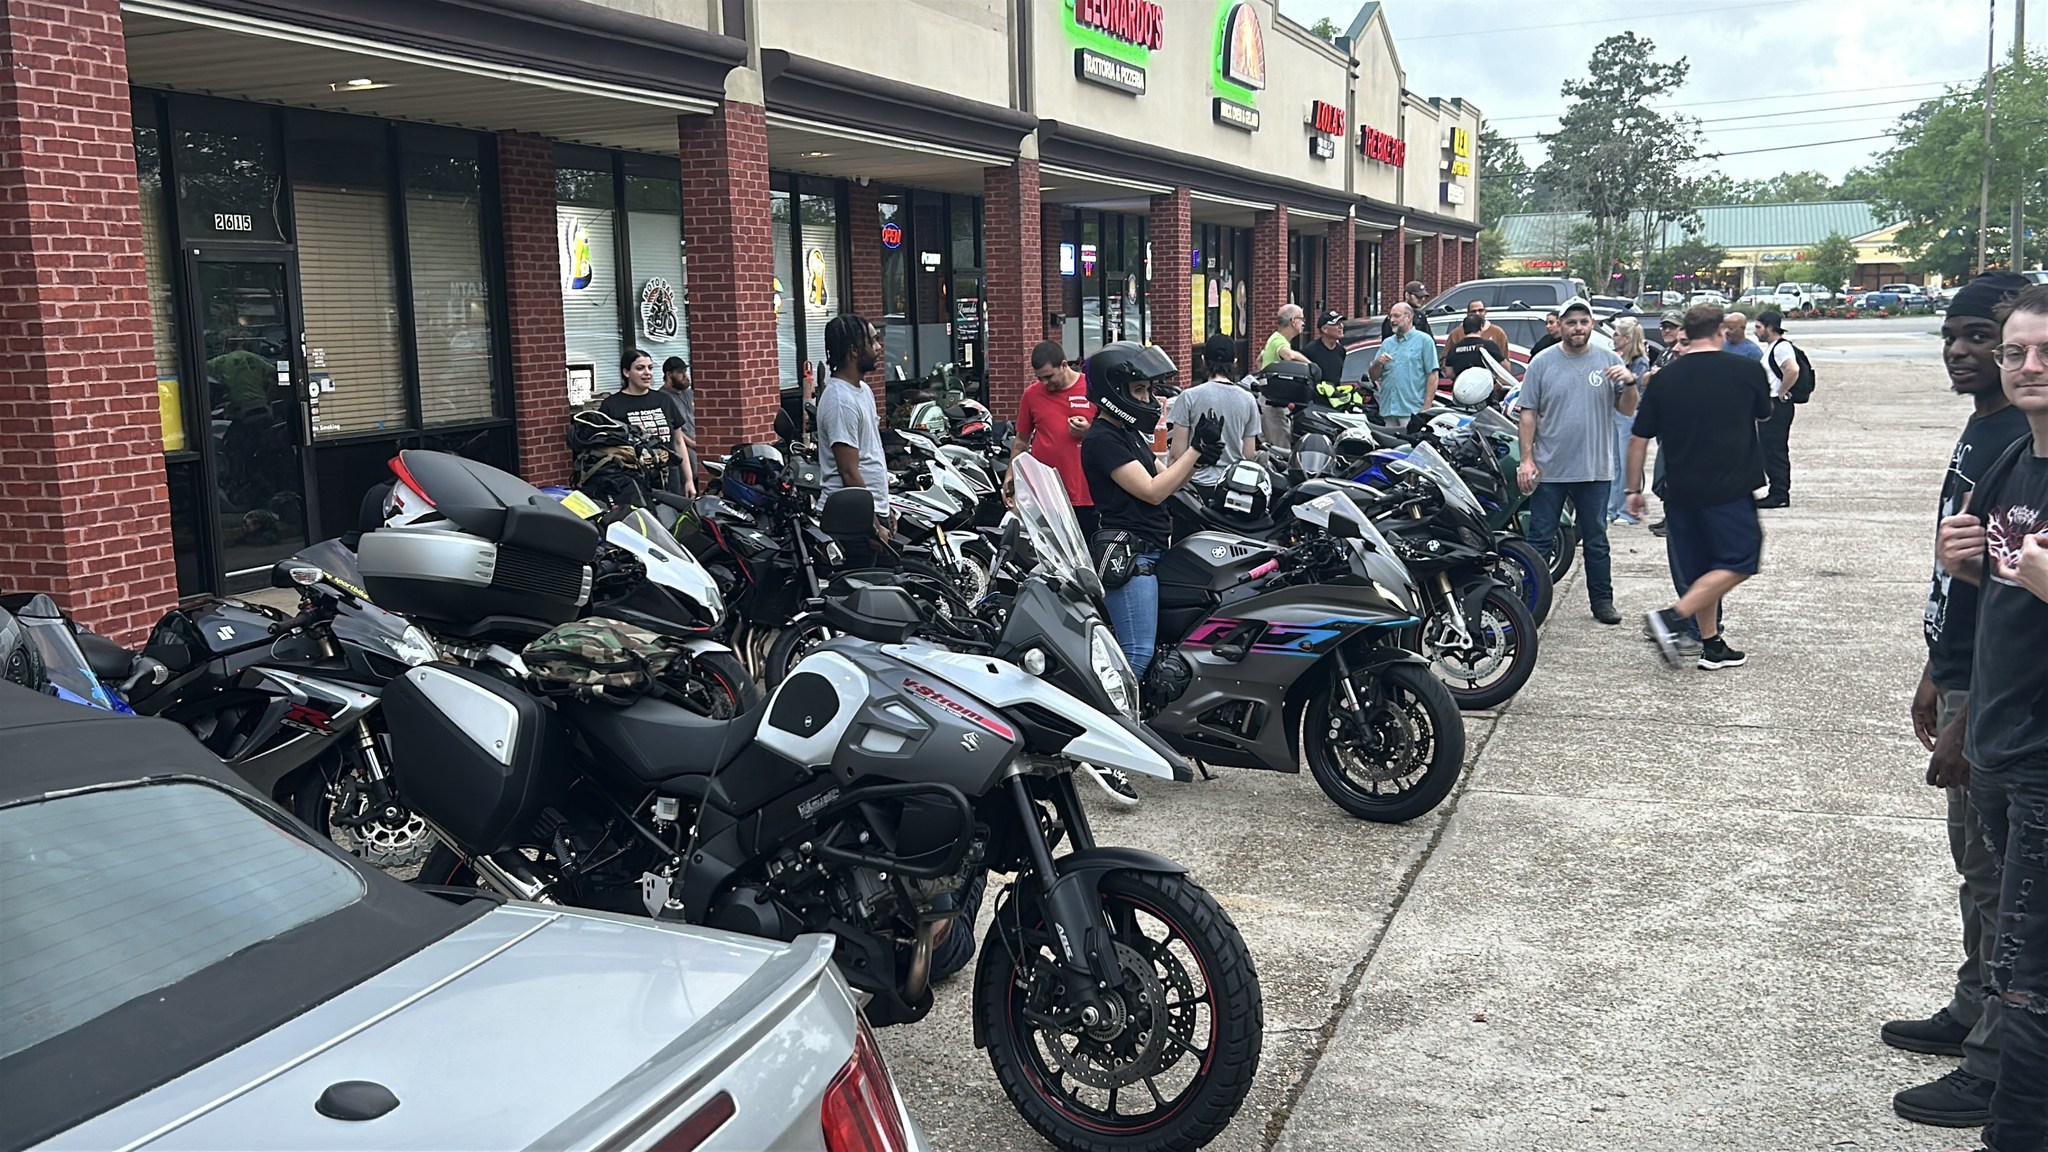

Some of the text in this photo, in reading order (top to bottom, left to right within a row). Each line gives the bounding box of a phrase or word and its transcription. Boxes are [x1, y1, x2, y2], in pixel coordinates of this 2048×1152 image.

[1083, 53, 1115, 80] TRATTORIA
[1120, 66, 1145, 90] PIZZERIA
[1315, 100, 1345, 137] LOLA'S
[1364, 126, 1378, 158] THE
[1377, 132, 1393, 163] BIKE
[215, 214, 252, 230] 2615
[882, 227, 902, 244] OPEN
[643, 278, 674, 299] MOTO BAR
[1055, 922, 1073, 962] ABS
